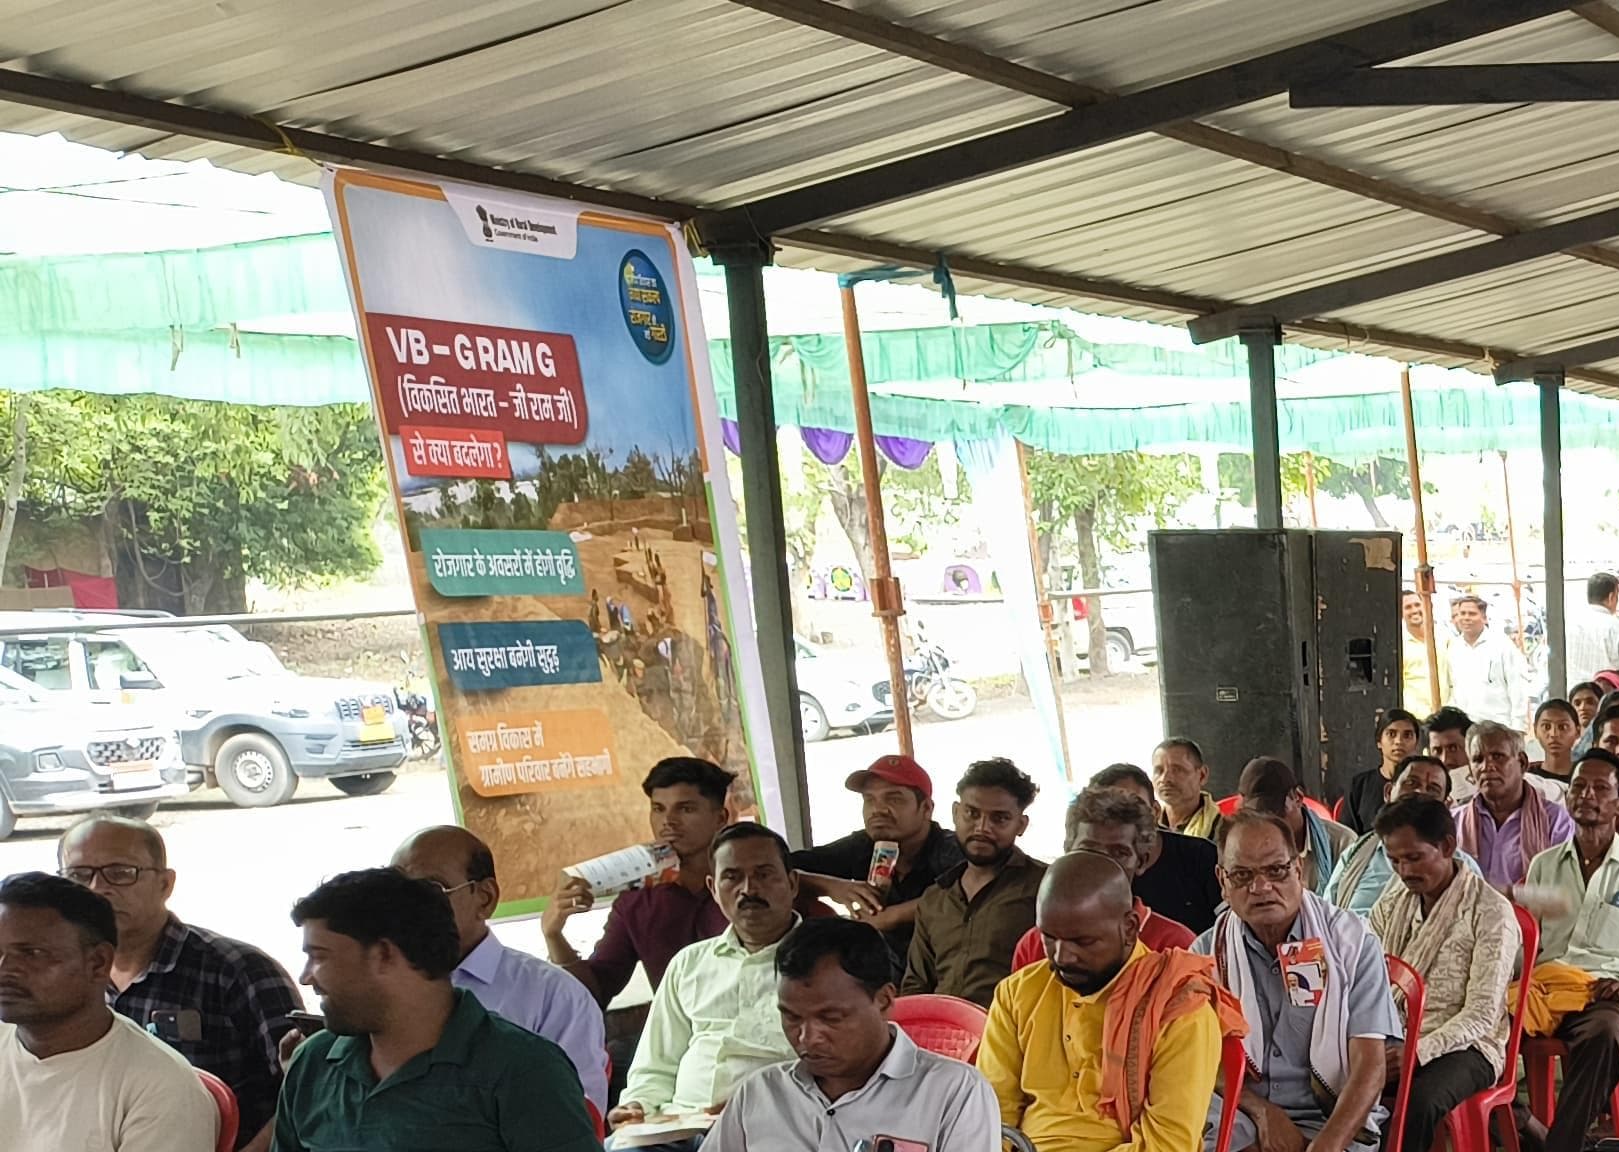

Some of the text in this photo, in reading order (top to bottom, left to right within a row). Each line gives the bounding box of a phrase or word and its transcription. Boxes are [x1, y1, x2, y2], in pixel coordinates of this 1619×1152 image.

[475, 336, 535, 376] RAM
[461, 387, 498, 418] भारत
[508, 383, 529, 420] जी
[527, 392, 556, 422] राम
[409, 430, 425, 465] से
[425, 438, 453, 467] क्या
[431, 547, 475, 577] रोजगार
[474, 547, 487, 577] के
[486, 548, 525, 577] अवसरों
[522, 548, 536, 577] में
[533, 548, 557, 577] होगी
[451, 648, 475, 671] आय
[474, 645, 509, 676] सुरक्षा
[507, 639, 537, 669] बनेगी
